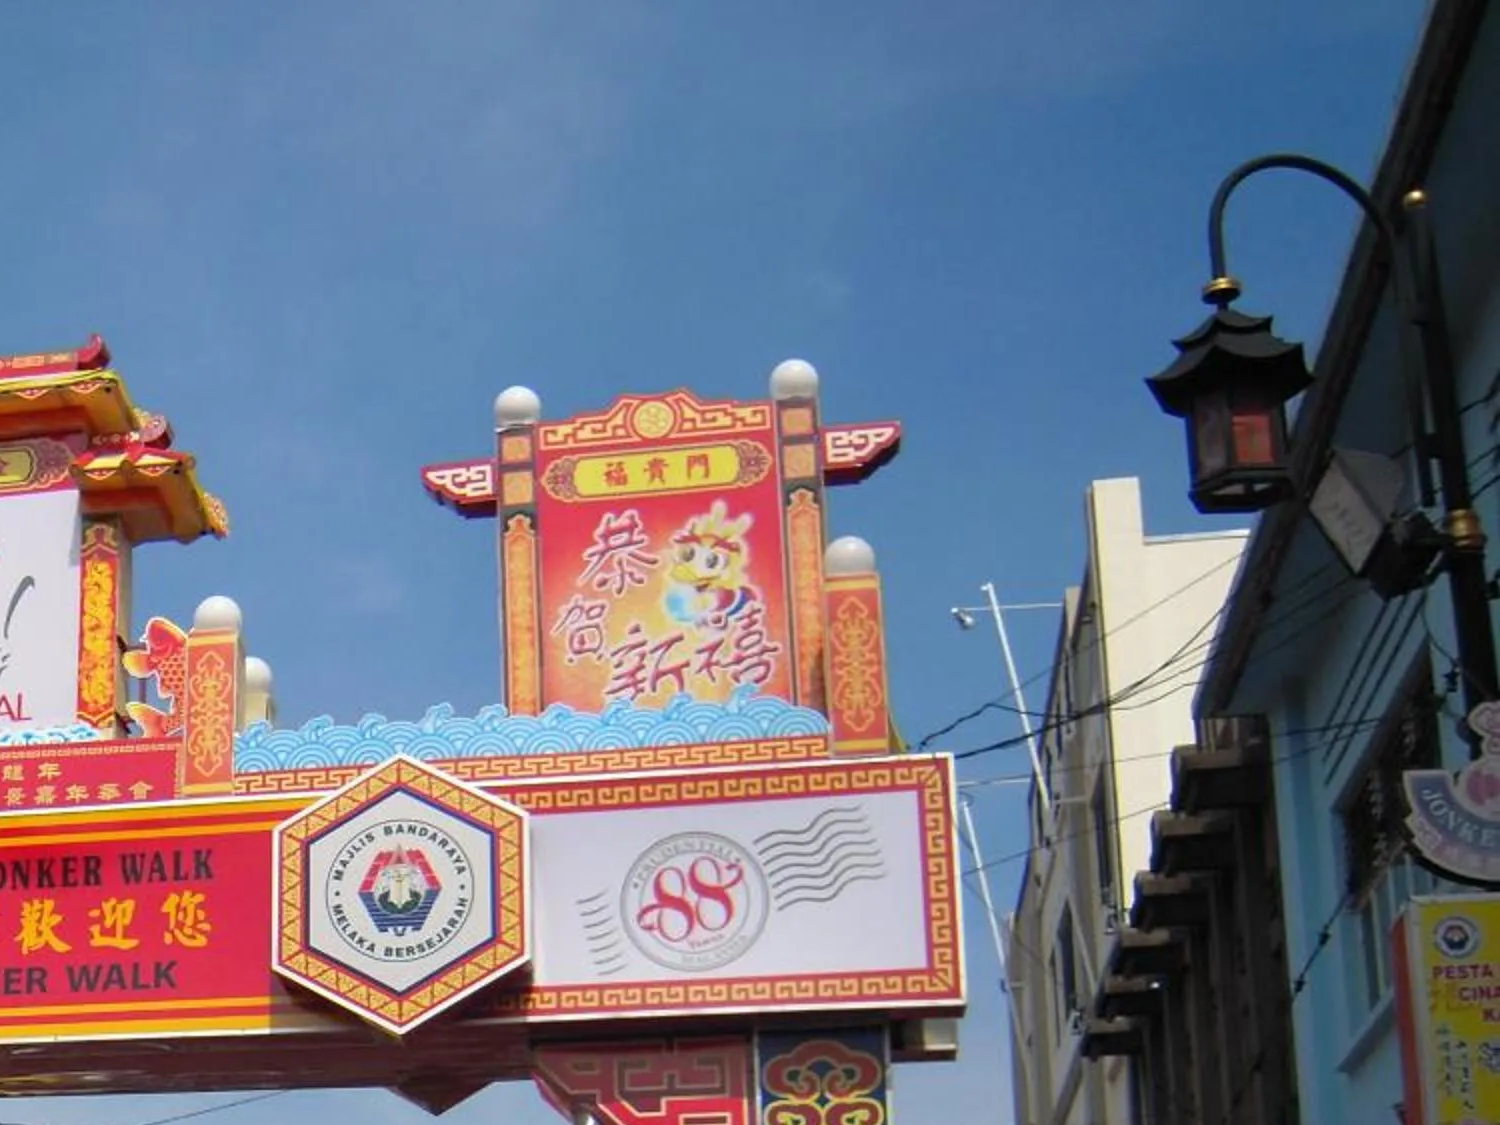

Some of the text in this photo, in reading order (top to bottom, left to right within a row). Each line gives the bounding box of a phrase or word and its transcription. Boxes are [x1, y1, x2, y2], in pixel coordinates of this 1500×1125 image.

[120, 848, 214, 885] WALK
[333, 824, 467, 881] MAJLIS BANDARAYA
[636, 855, 743, 942] 88
[332, 897, 469, 958] MELAKA BERSEJARAH
[65, 960, 179, 993] WALK
[1432, 964, 1493, 979] PESTA
